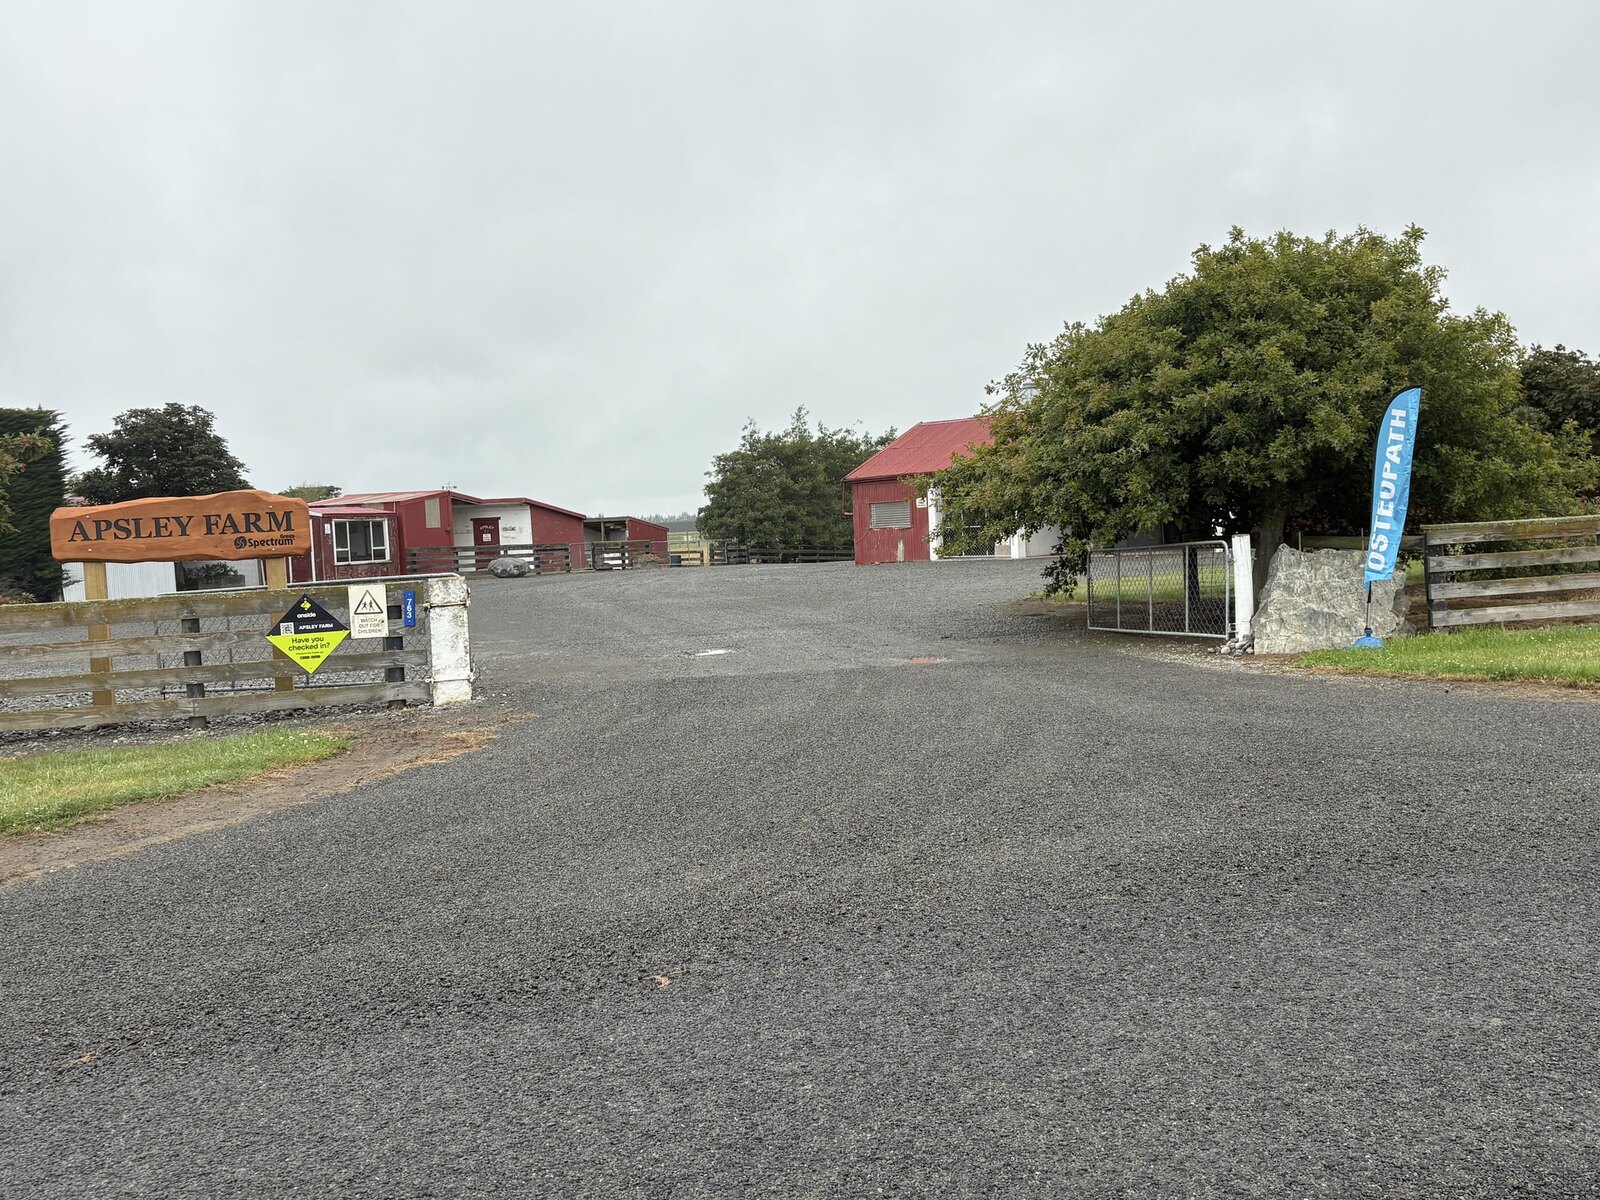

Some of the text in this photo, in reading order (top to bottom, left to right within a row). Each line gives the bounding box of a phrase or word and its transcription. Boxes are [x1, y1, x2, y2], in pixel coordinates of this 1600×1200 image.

[68, 510, 295, 542] APSLEY FARM
[247, 537, 293, 549] Spectrum
[310, 636, 325, 644] you
[288, 641, 331, 652] checked in?
